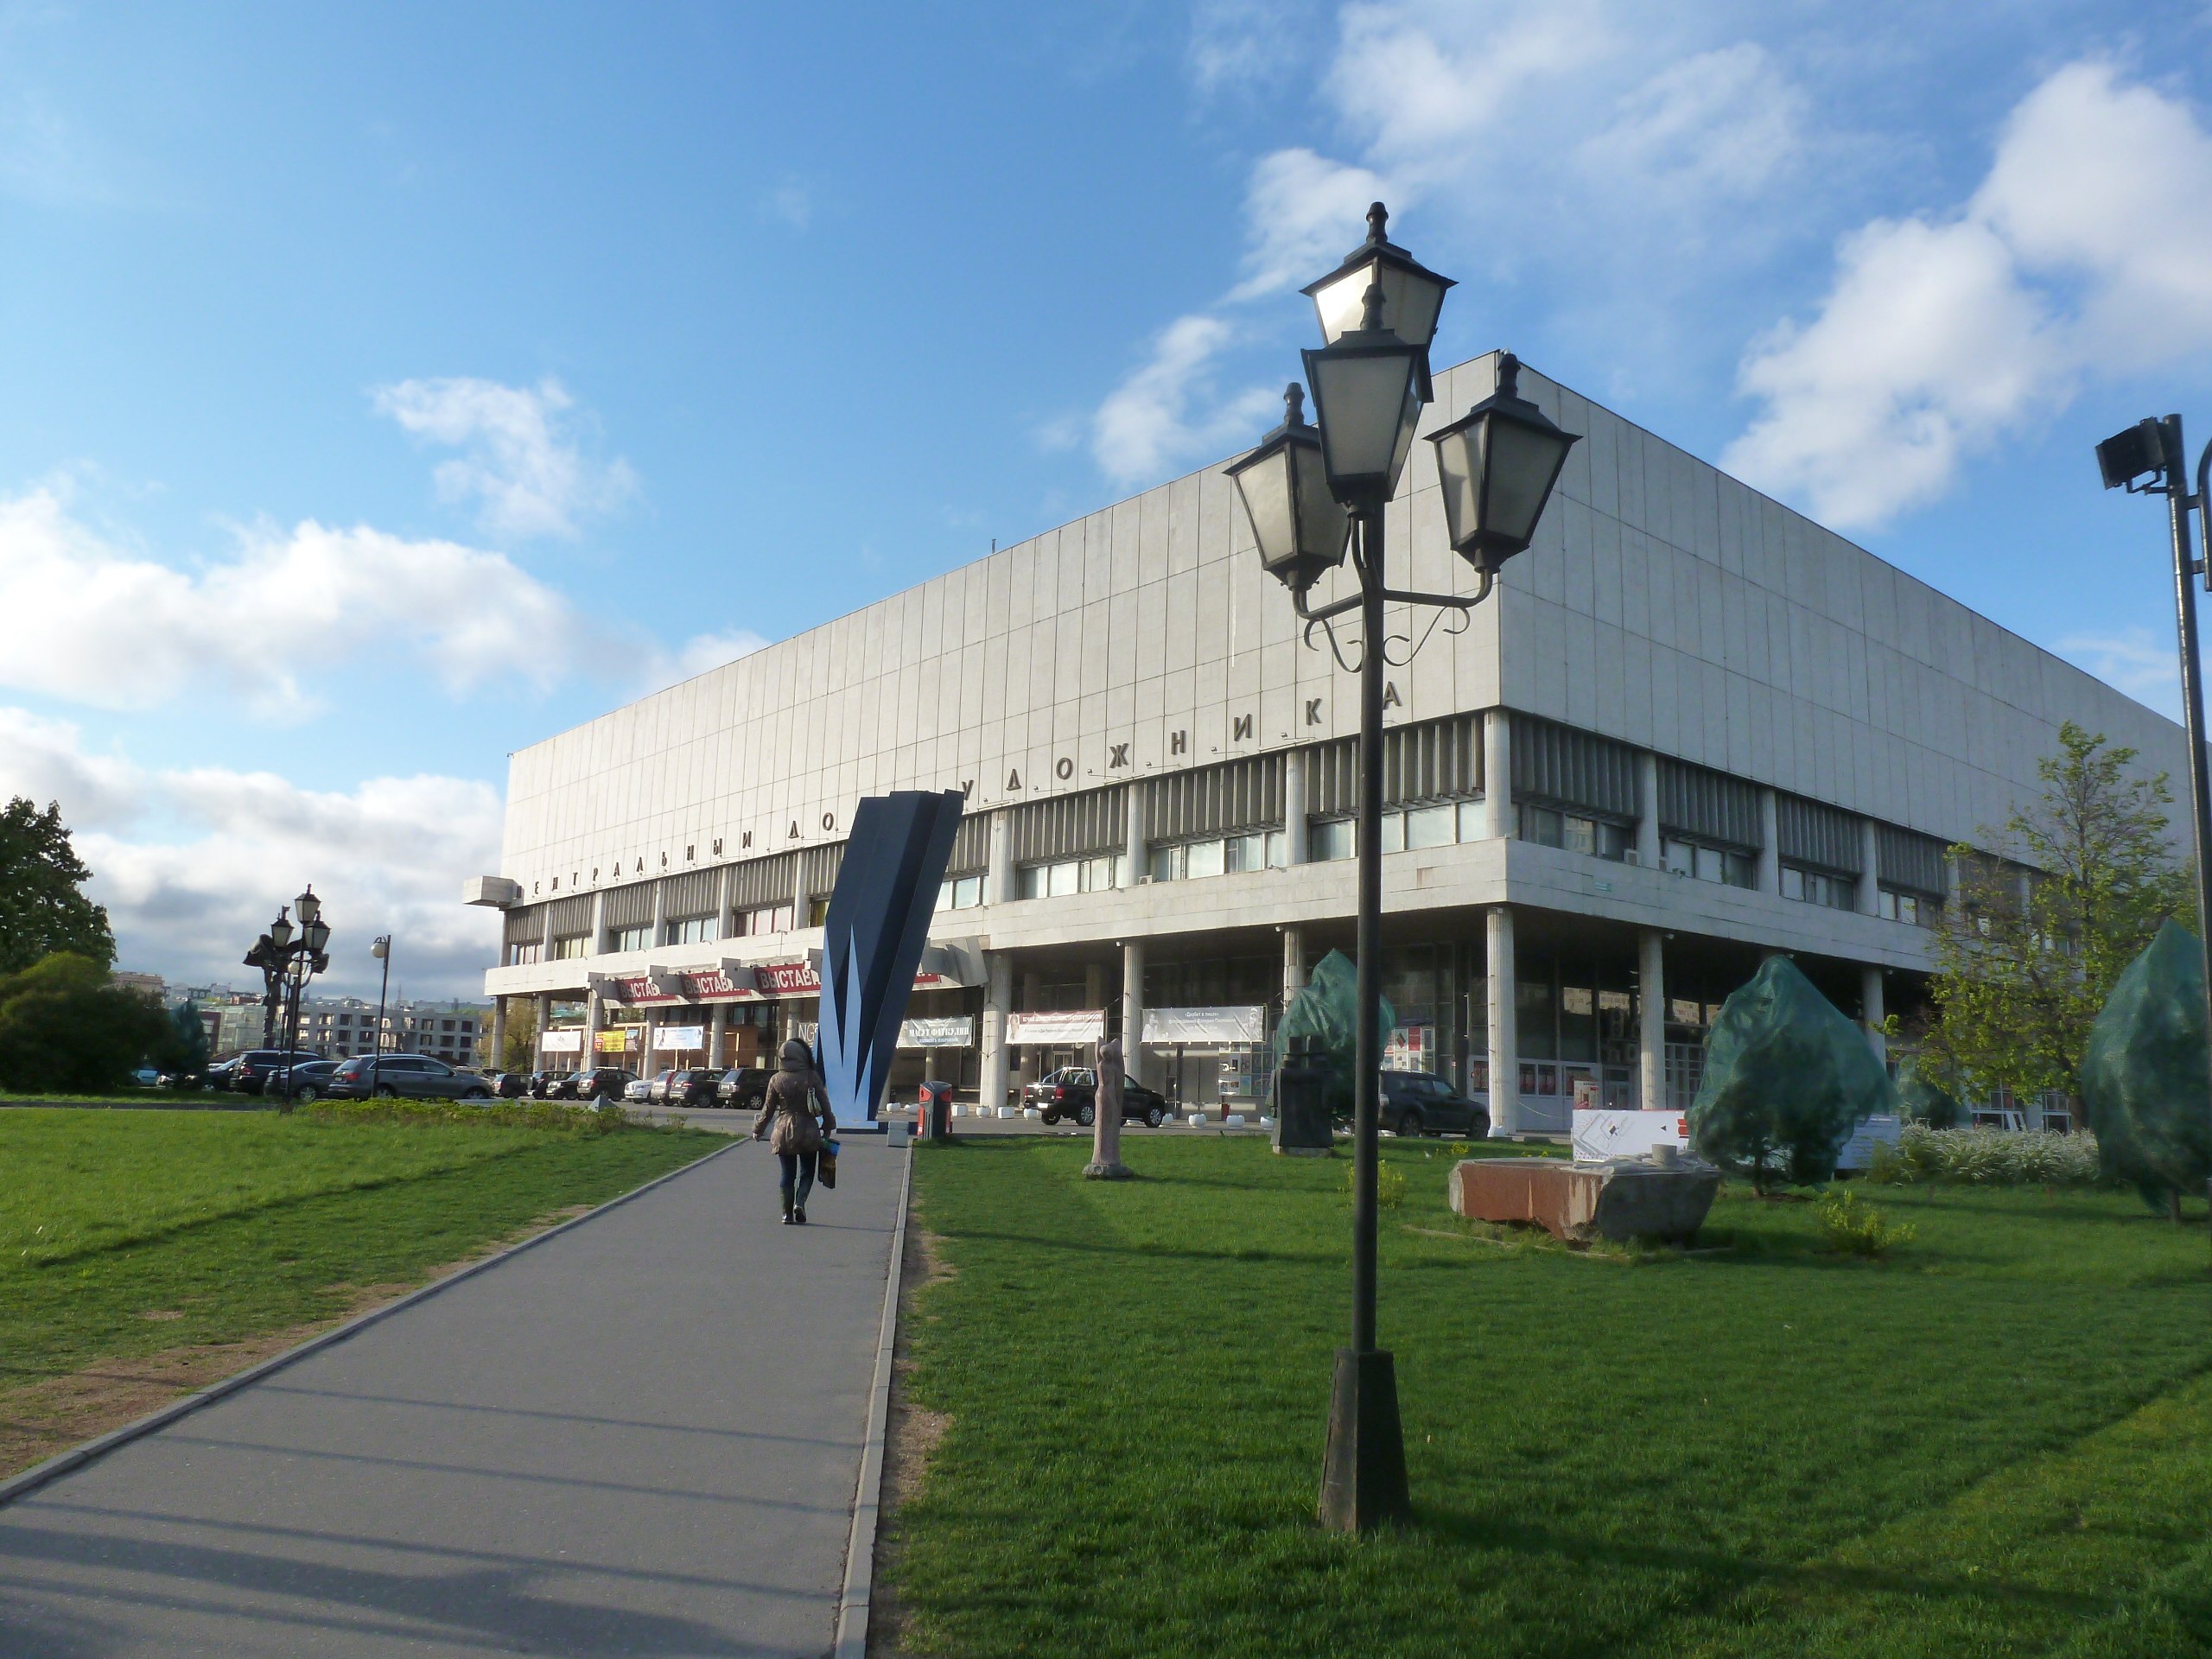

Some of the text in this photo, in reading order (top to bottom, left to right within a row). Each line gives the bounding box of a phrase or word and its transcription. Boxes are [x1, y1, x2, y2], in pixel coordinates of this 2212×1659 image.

[787, 812, 835, 839] ДО
[960, 680, 1403, 801] УДОЖНИКА
[620, 982, 668, 999] ВЫСТАВ
[684, 976, 745, 995] ВЫСТАВ
